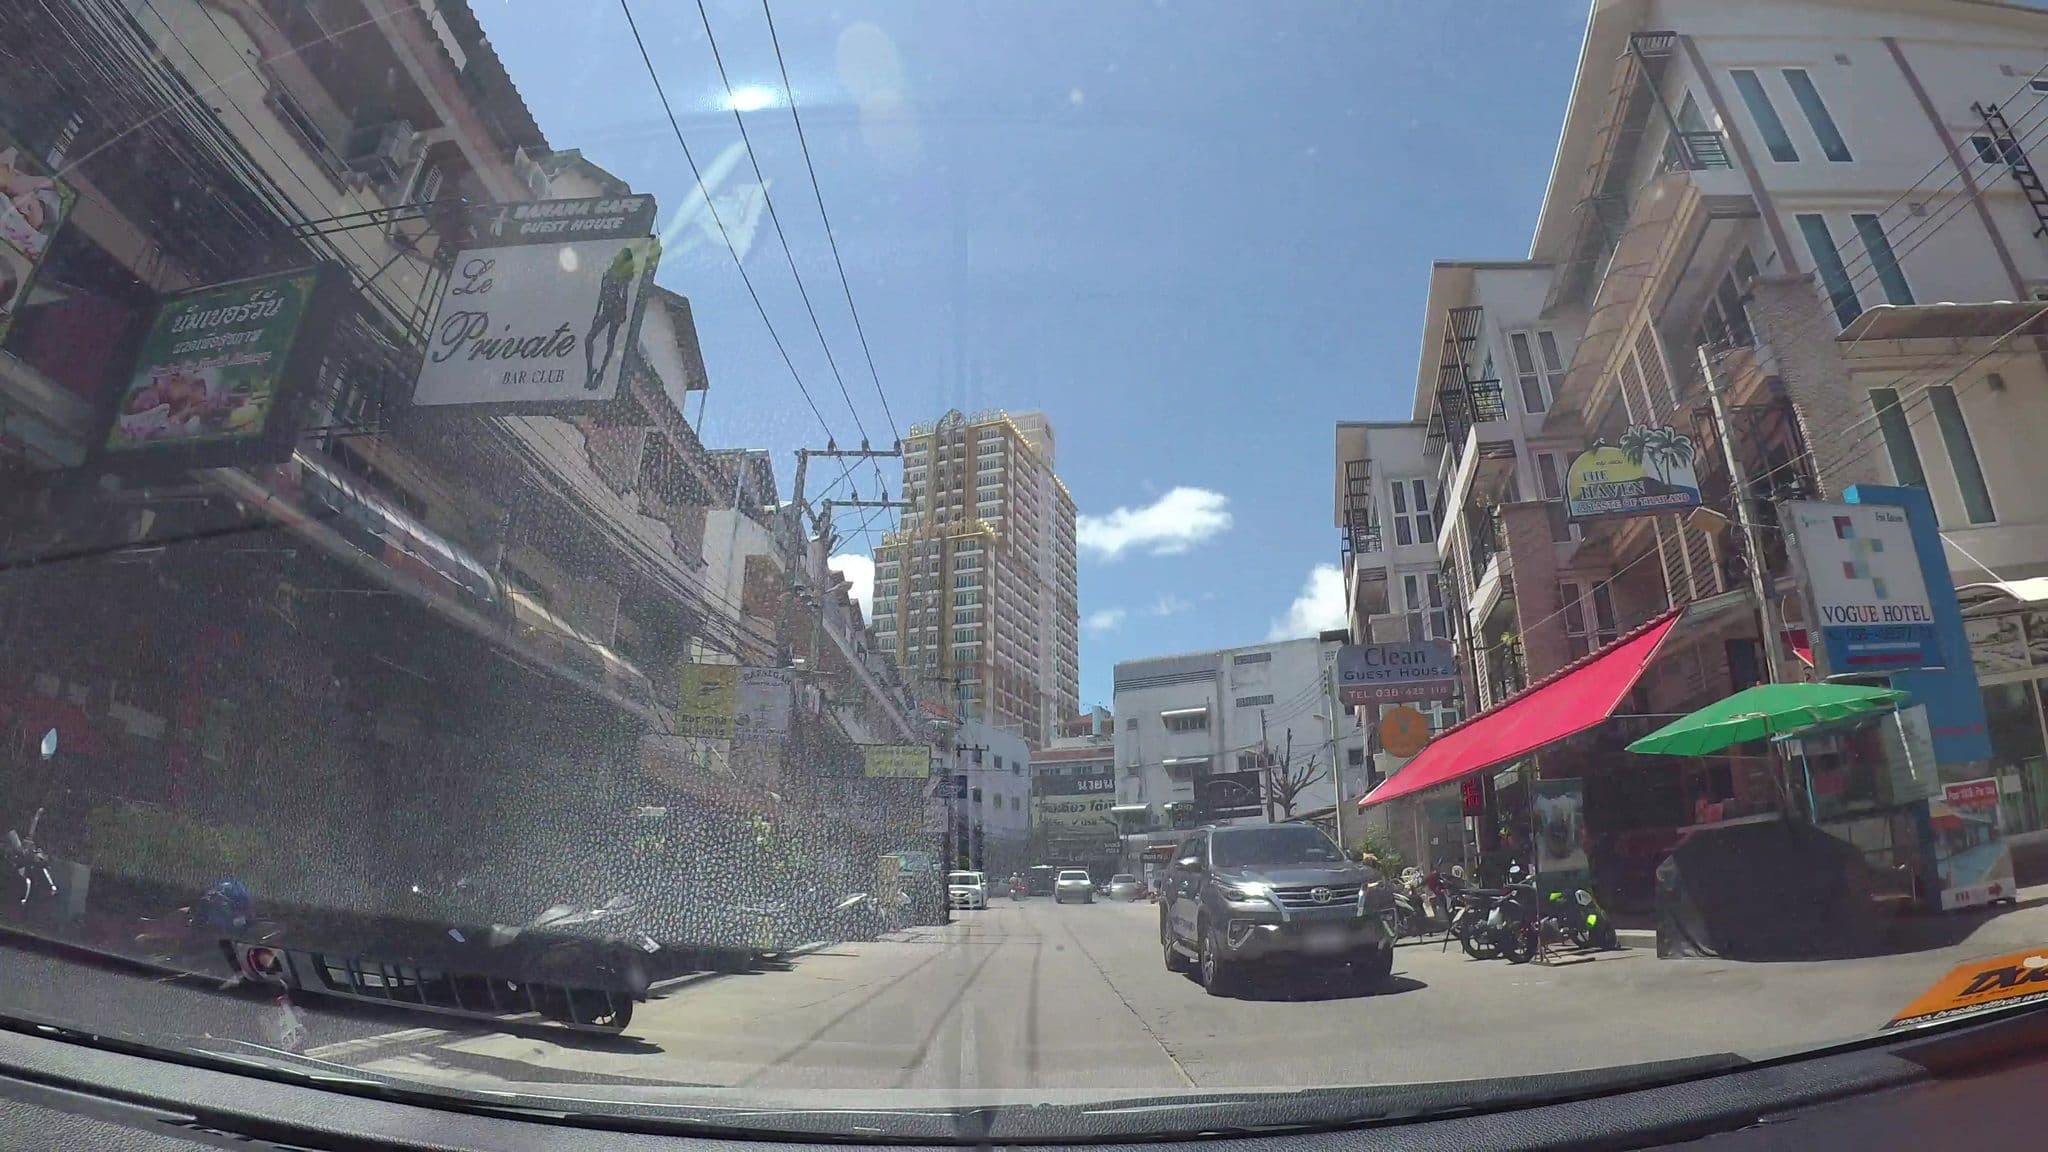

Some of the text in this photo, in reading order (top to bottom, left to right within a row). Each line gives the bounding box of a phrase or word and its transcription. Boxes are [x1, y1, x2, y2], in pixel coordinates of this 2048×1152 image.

[513, 198, 646, 220] BANANA CAFE
[519, 216, 626, 234] GUEST HOUSE
[452, 258, 496, 296] Le
[432, 310, 576, 363] Private
[502, 369, 567, 385] BAR CLUB
[1583, 469, 1608, 481] THE
[1579, 480, 1646, 499] HAVEN
[1822, 604, 1931, 623] VOGUE HOTEL
[1364, 647, 1426, 667] Clean
[1344, 666, 1449, 680] GUEST HOUSE
